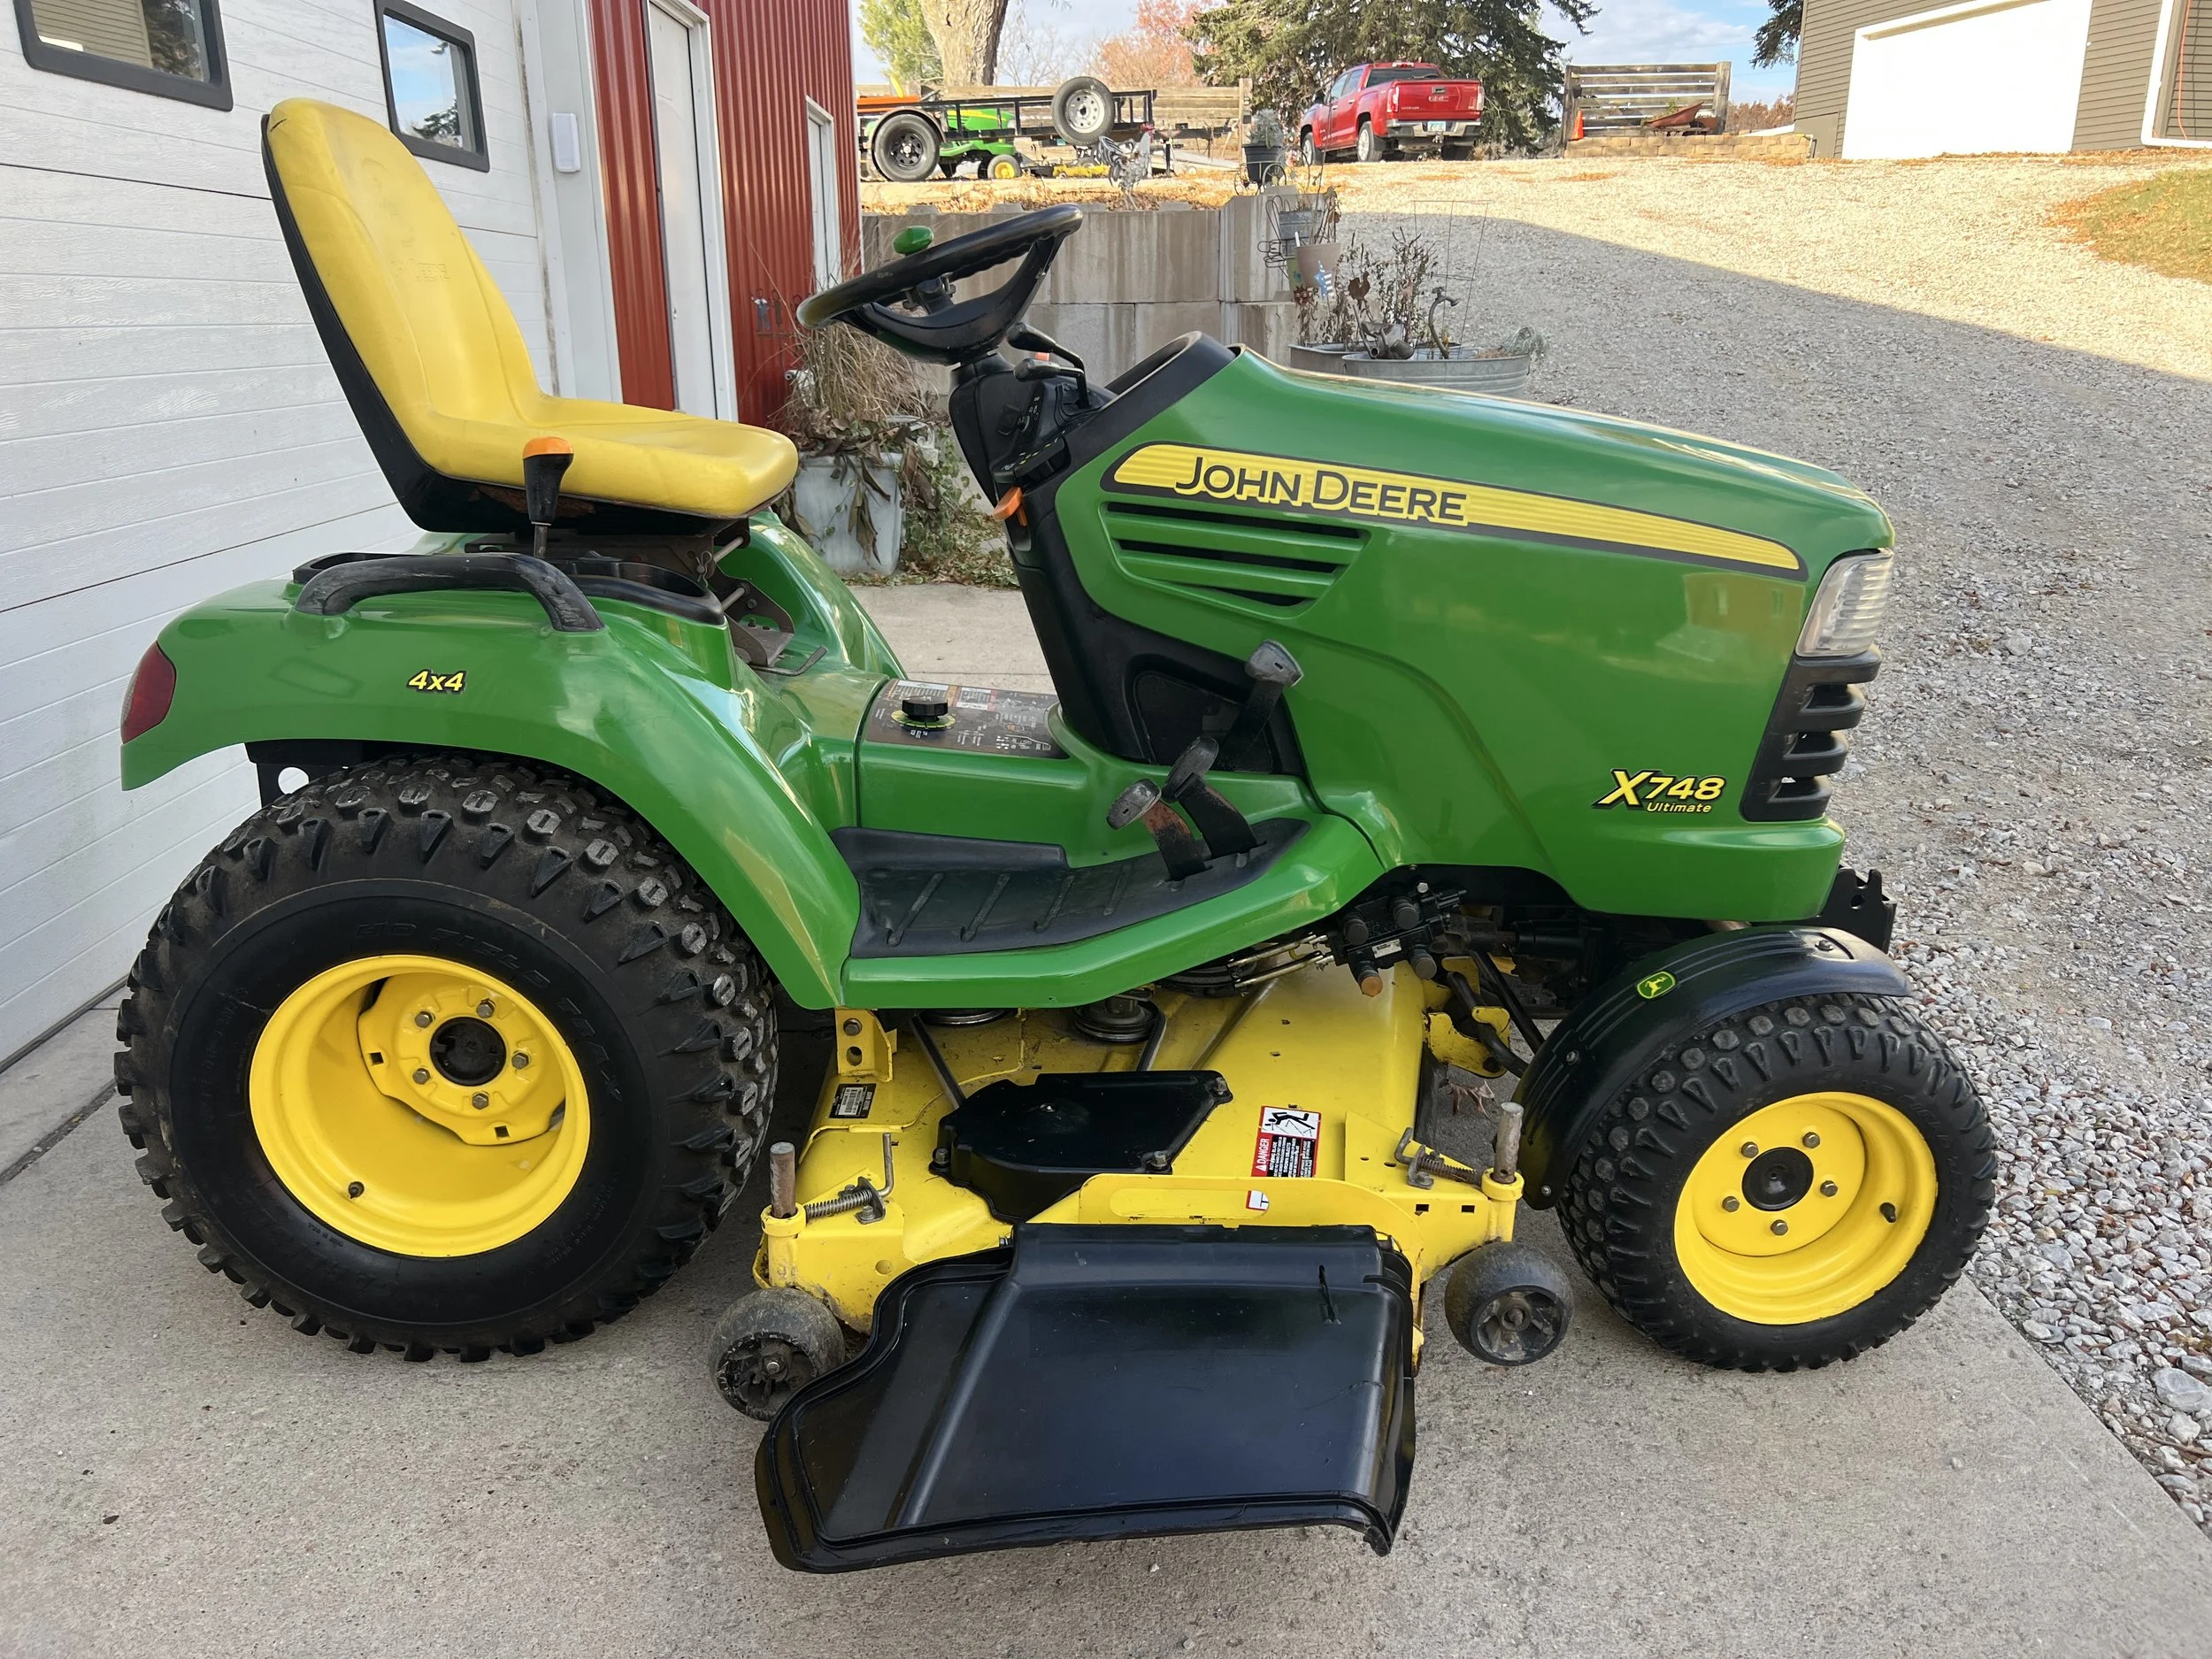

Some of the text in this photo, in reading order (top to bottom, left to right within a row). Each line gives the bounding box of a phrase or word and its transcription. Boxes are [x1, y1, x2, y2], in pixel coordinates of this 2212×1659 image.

[1176, 456, 1468, 522] JOHN DEERE
[408, 670, 465, 692] 4x4
[1595, 770, 1726, 807] X748
[1647, 802, 1713, 813] Ultimate
[1256, 1138, 1269, 1164] DANGER
